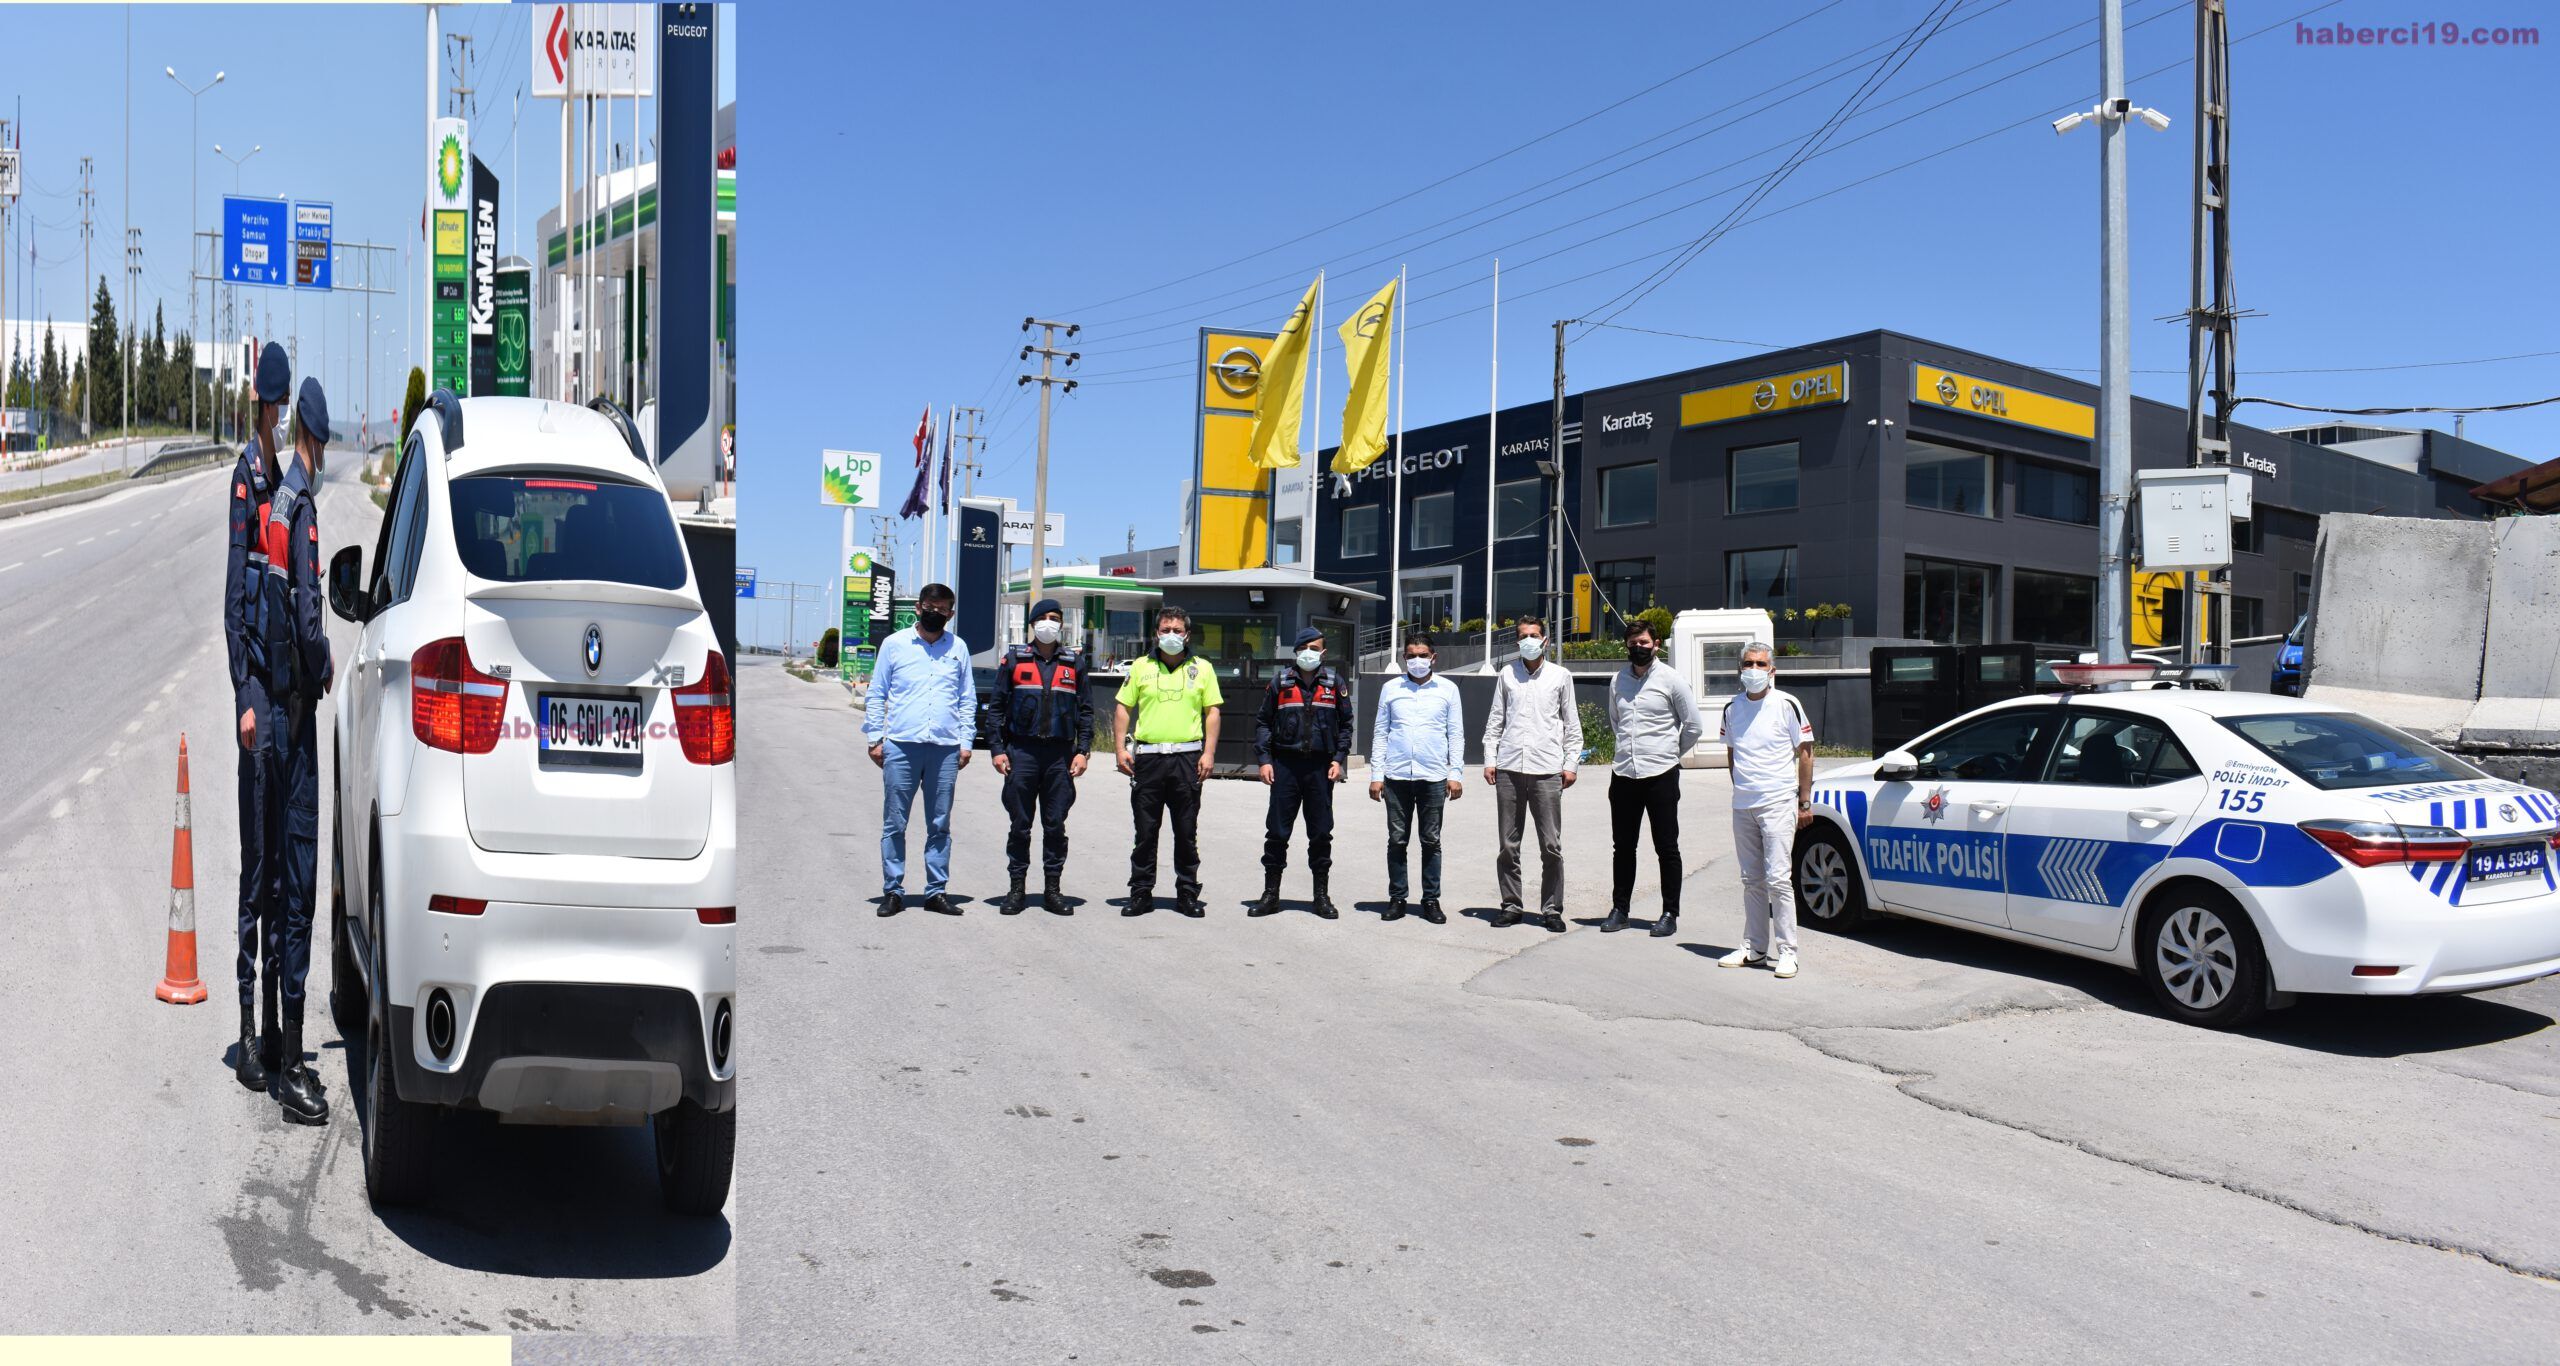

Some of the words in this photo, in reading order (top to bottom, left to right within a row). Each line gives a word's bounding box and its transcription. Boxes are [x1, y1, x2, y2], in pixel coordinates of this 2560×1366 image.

[667, 24, 708, 38] PEUGEOT
[242, 213, 269, 226] Merzifon
[242, 228, 266, 240] Samsun
[298, 226, 322, 240] Ortaköy
[1790, 374, 1838, 401] OPEL
[1971, 385, 2008, 415] OPEL
[1602, 411, 1654, 433] Karataş
[1501, 437, 1550, 457] KARATAŞ
[847, 454, 872, 477] bp
[1357, 444, 1469, 483] PEUGEOT
[2243, 451, 2277, 479] Karataş
[549, 702, 568, 745] 06
[576, 702, 604, 747] CGU
[612, 705, 640, 750] 324
[2225, 760, 2278, 774] @EmniyetGM
[2213, 770, 2247, 784] POLİS
[2248, 772, 2290, 788] İMDAT
[2219, 789, 2267, 813] 155
[1869, 833, 1933, 874] TRAFİK
[1936, 839, 2000, 881] POLİSİ
[2476, 856, 2492, 872] 19
[2496, 854, 2505, 871] A
[2508, 849, 2539, 869] 5936
